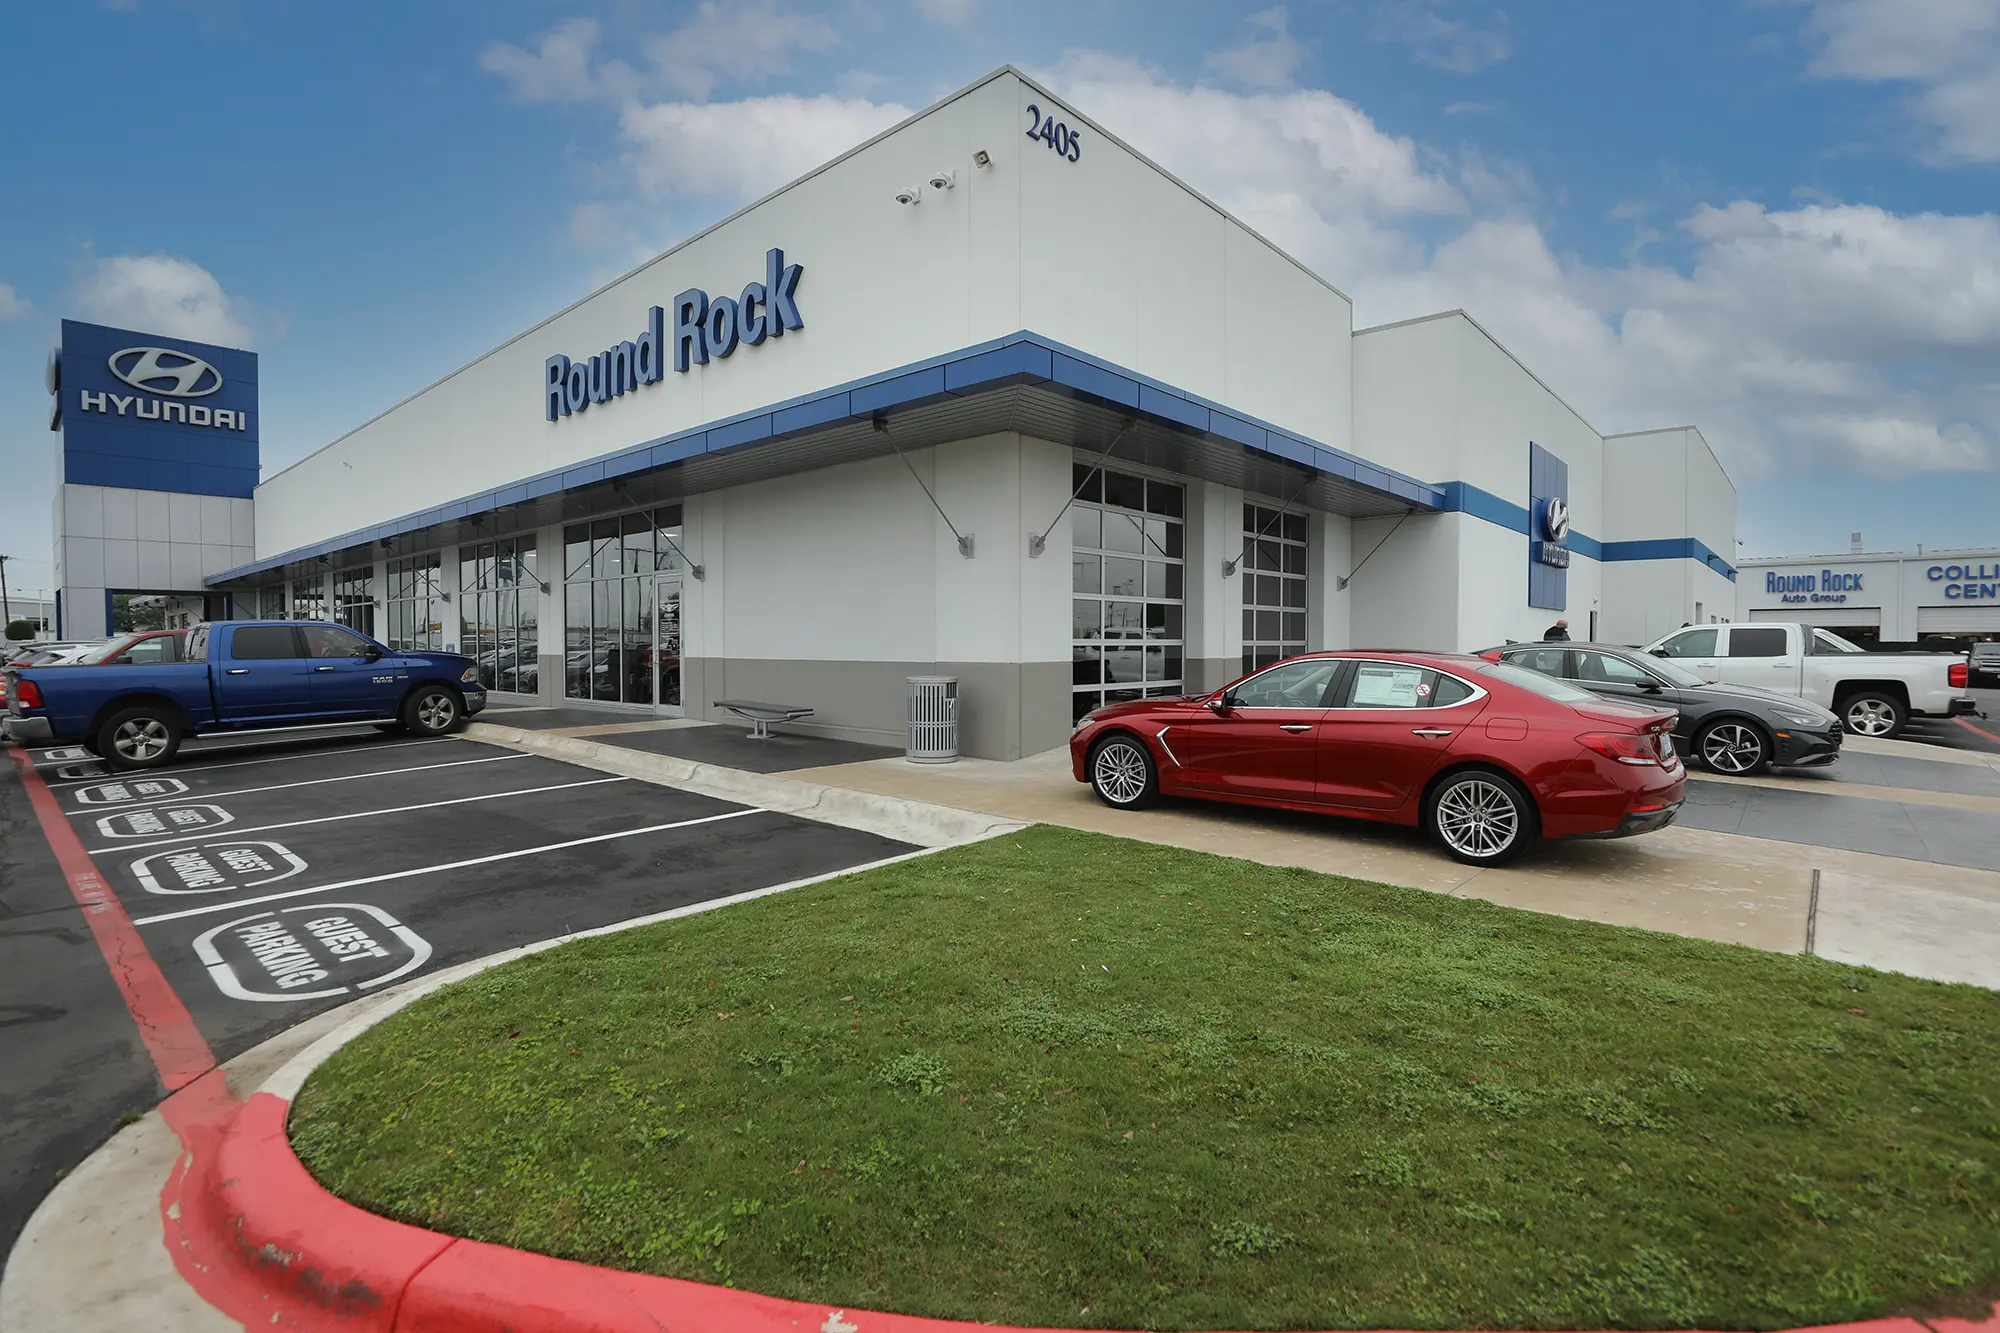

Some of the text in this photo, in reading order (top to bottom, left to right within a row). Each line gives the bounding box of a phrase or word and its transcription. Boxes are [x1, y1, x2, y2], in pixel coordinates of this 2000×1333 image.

[1026, 104, 1080, 162] 2405
[545, 247, 804, 422] Round Rock
[81, 389, 246, 431] HYUNDAI
[1766, 569, 1864, 593] ROUND ROCK
[1927, 564, 2000, 582] COLLI
[1944, 582, 2000, 599] CEN
[1781, 593, 1847, 604] Auto Group
[164, 851, 226, 888] PARKING
[218, 848, 274, 874] GUEST
[234, 921, 329, 989] PARKING
[303, 916, 390, 962] GUEST
